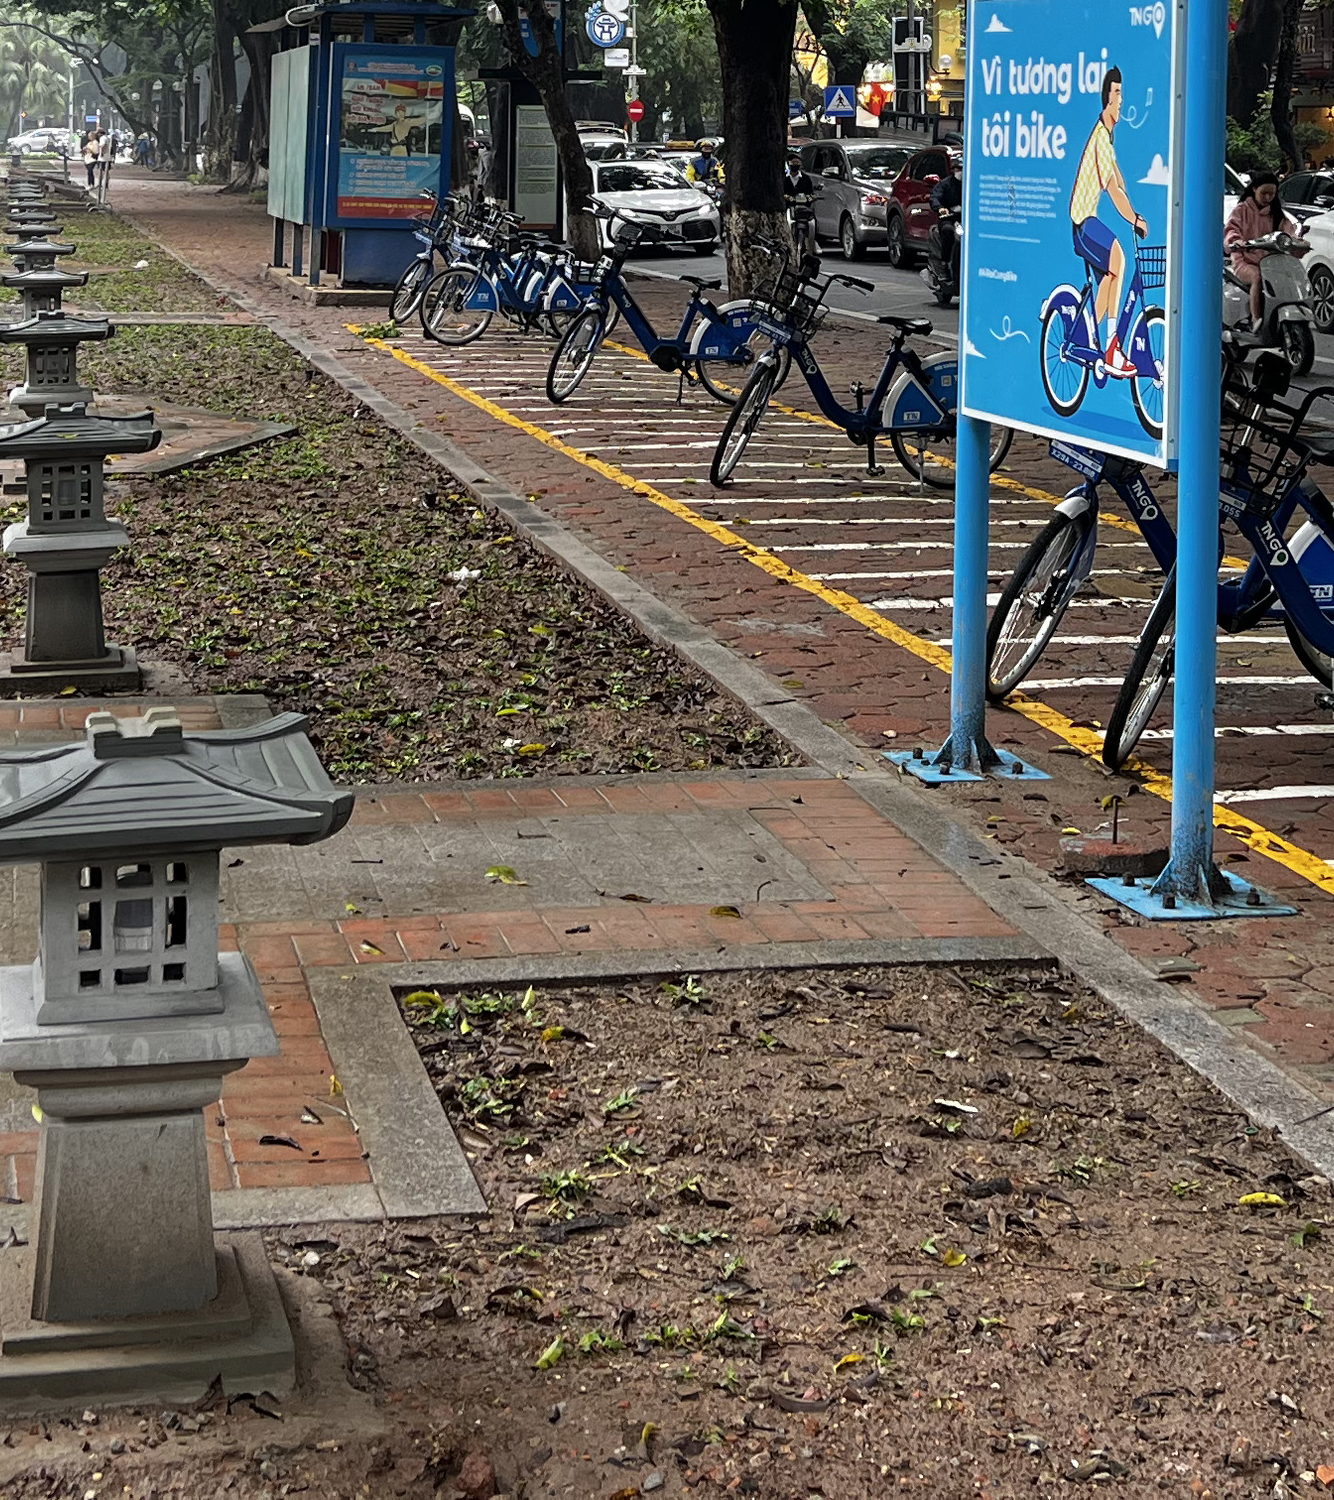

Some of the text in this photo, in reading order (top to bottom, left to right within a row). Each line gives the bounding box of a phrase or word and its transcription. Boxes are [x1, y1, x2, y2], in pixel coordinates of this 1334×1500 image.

[981, 47, 1108, 105] Vì tương lai
[981, 110, 1067, 160] tôi bike
